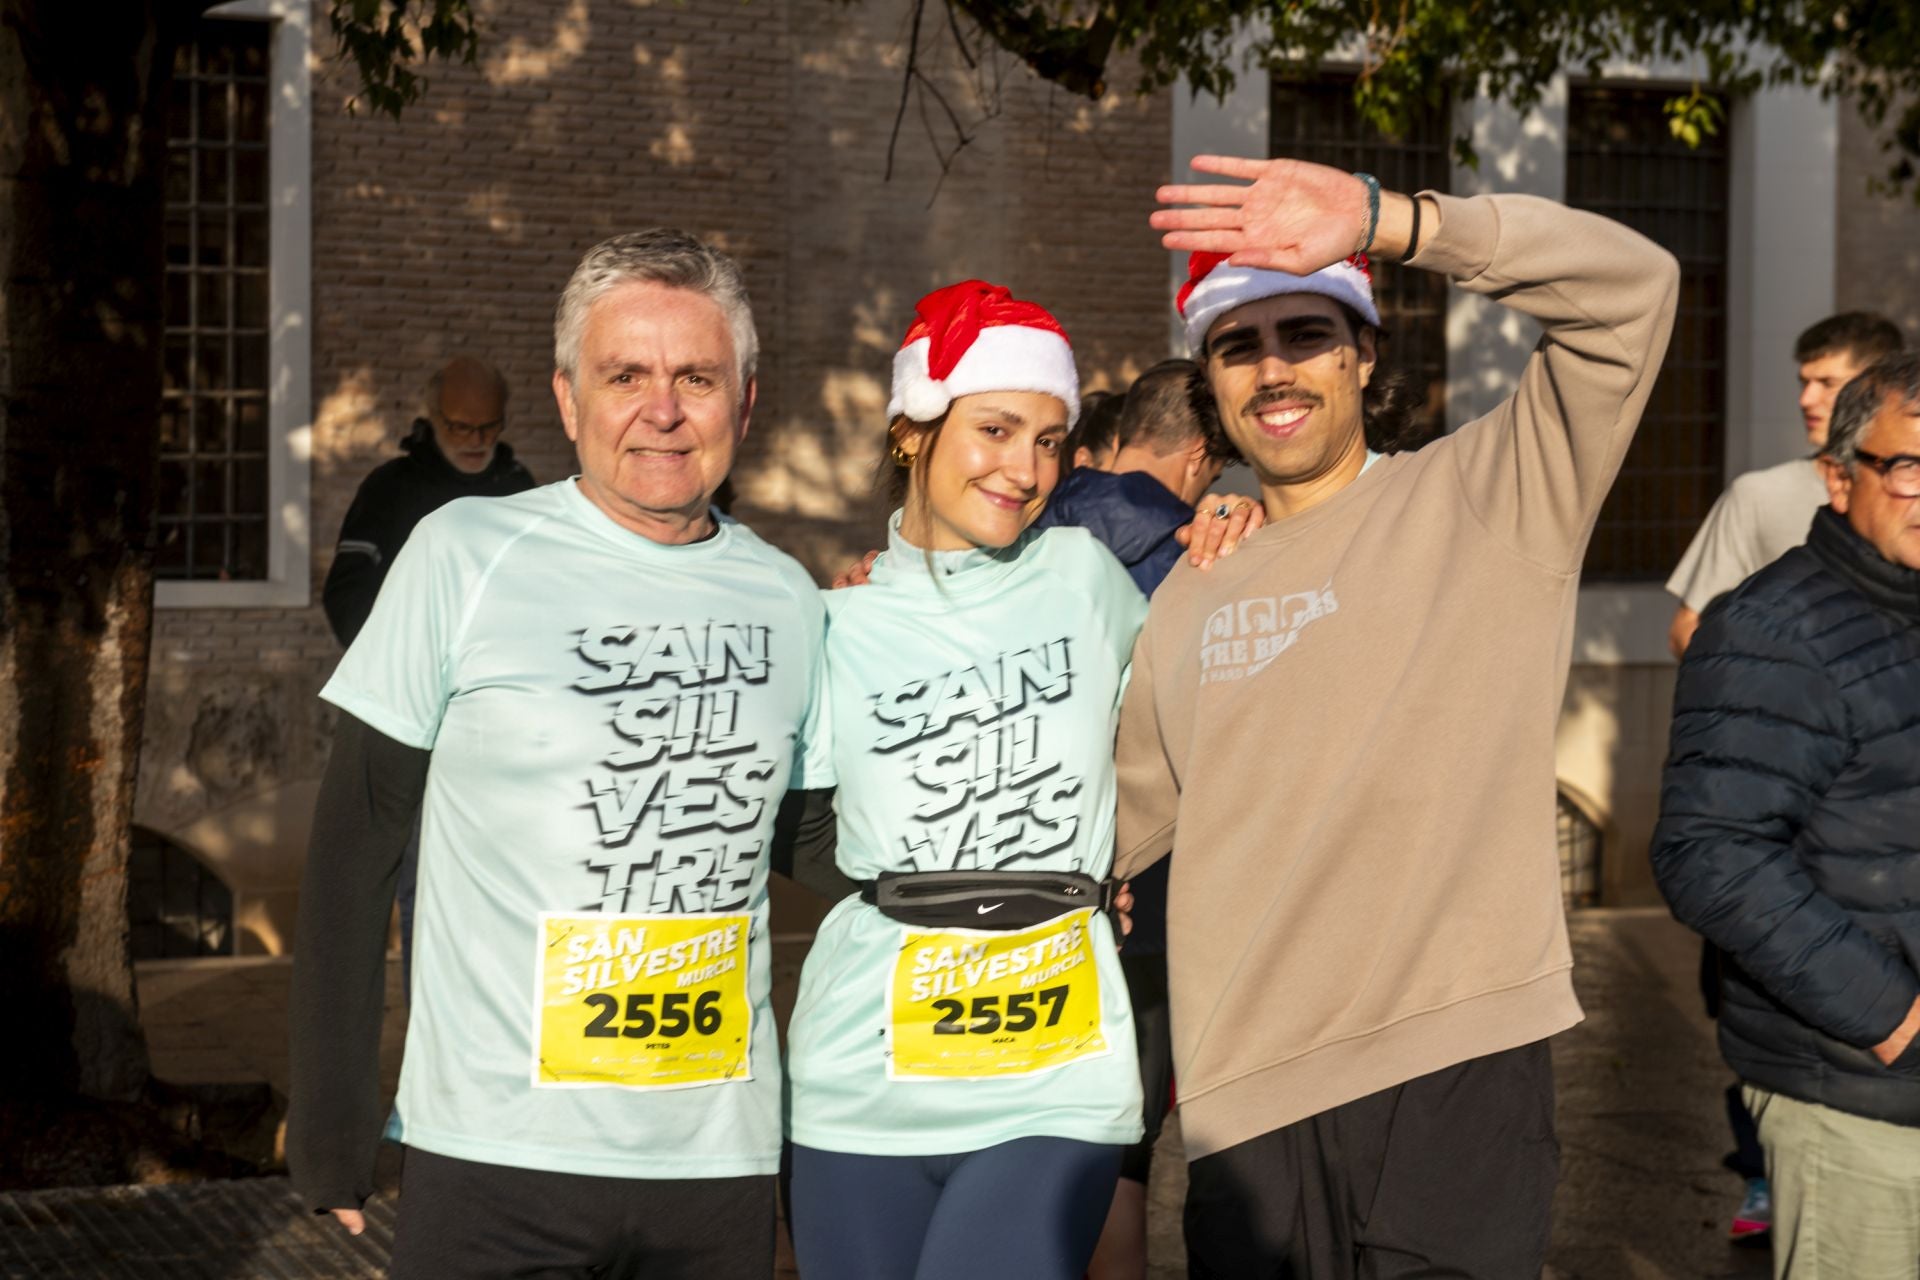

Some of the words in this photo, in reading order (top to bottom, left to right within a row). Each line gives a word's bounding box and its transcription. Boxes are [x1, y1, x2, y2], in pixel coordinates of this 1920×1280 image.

[568, 621, 772, 695] SAN
[1200, 639, 1248, 670] THE
[602, 690, 758, 773] SIL
[868, 636, 1072, 755] SAN
[577, 758, 778, 849] VES
[904, 714, 1062, 822] SIL
[899, 776, 1083, 872] VES
[580, 840, 763, 912] TRE
[561, 923, 740, 996] SILVESTRE
[563, 927, 647, 965] SAN
[676, 956, 738, 988] MURCIA
[910, 919, 1084, 1003] SILVESTRE
[912, 943, 989, 975] SAN
[1020, 950, 1086, 989] MURCIA
[583, 990, 722, 1039] 2556
[931, 984, 1070, 1036] 2557
